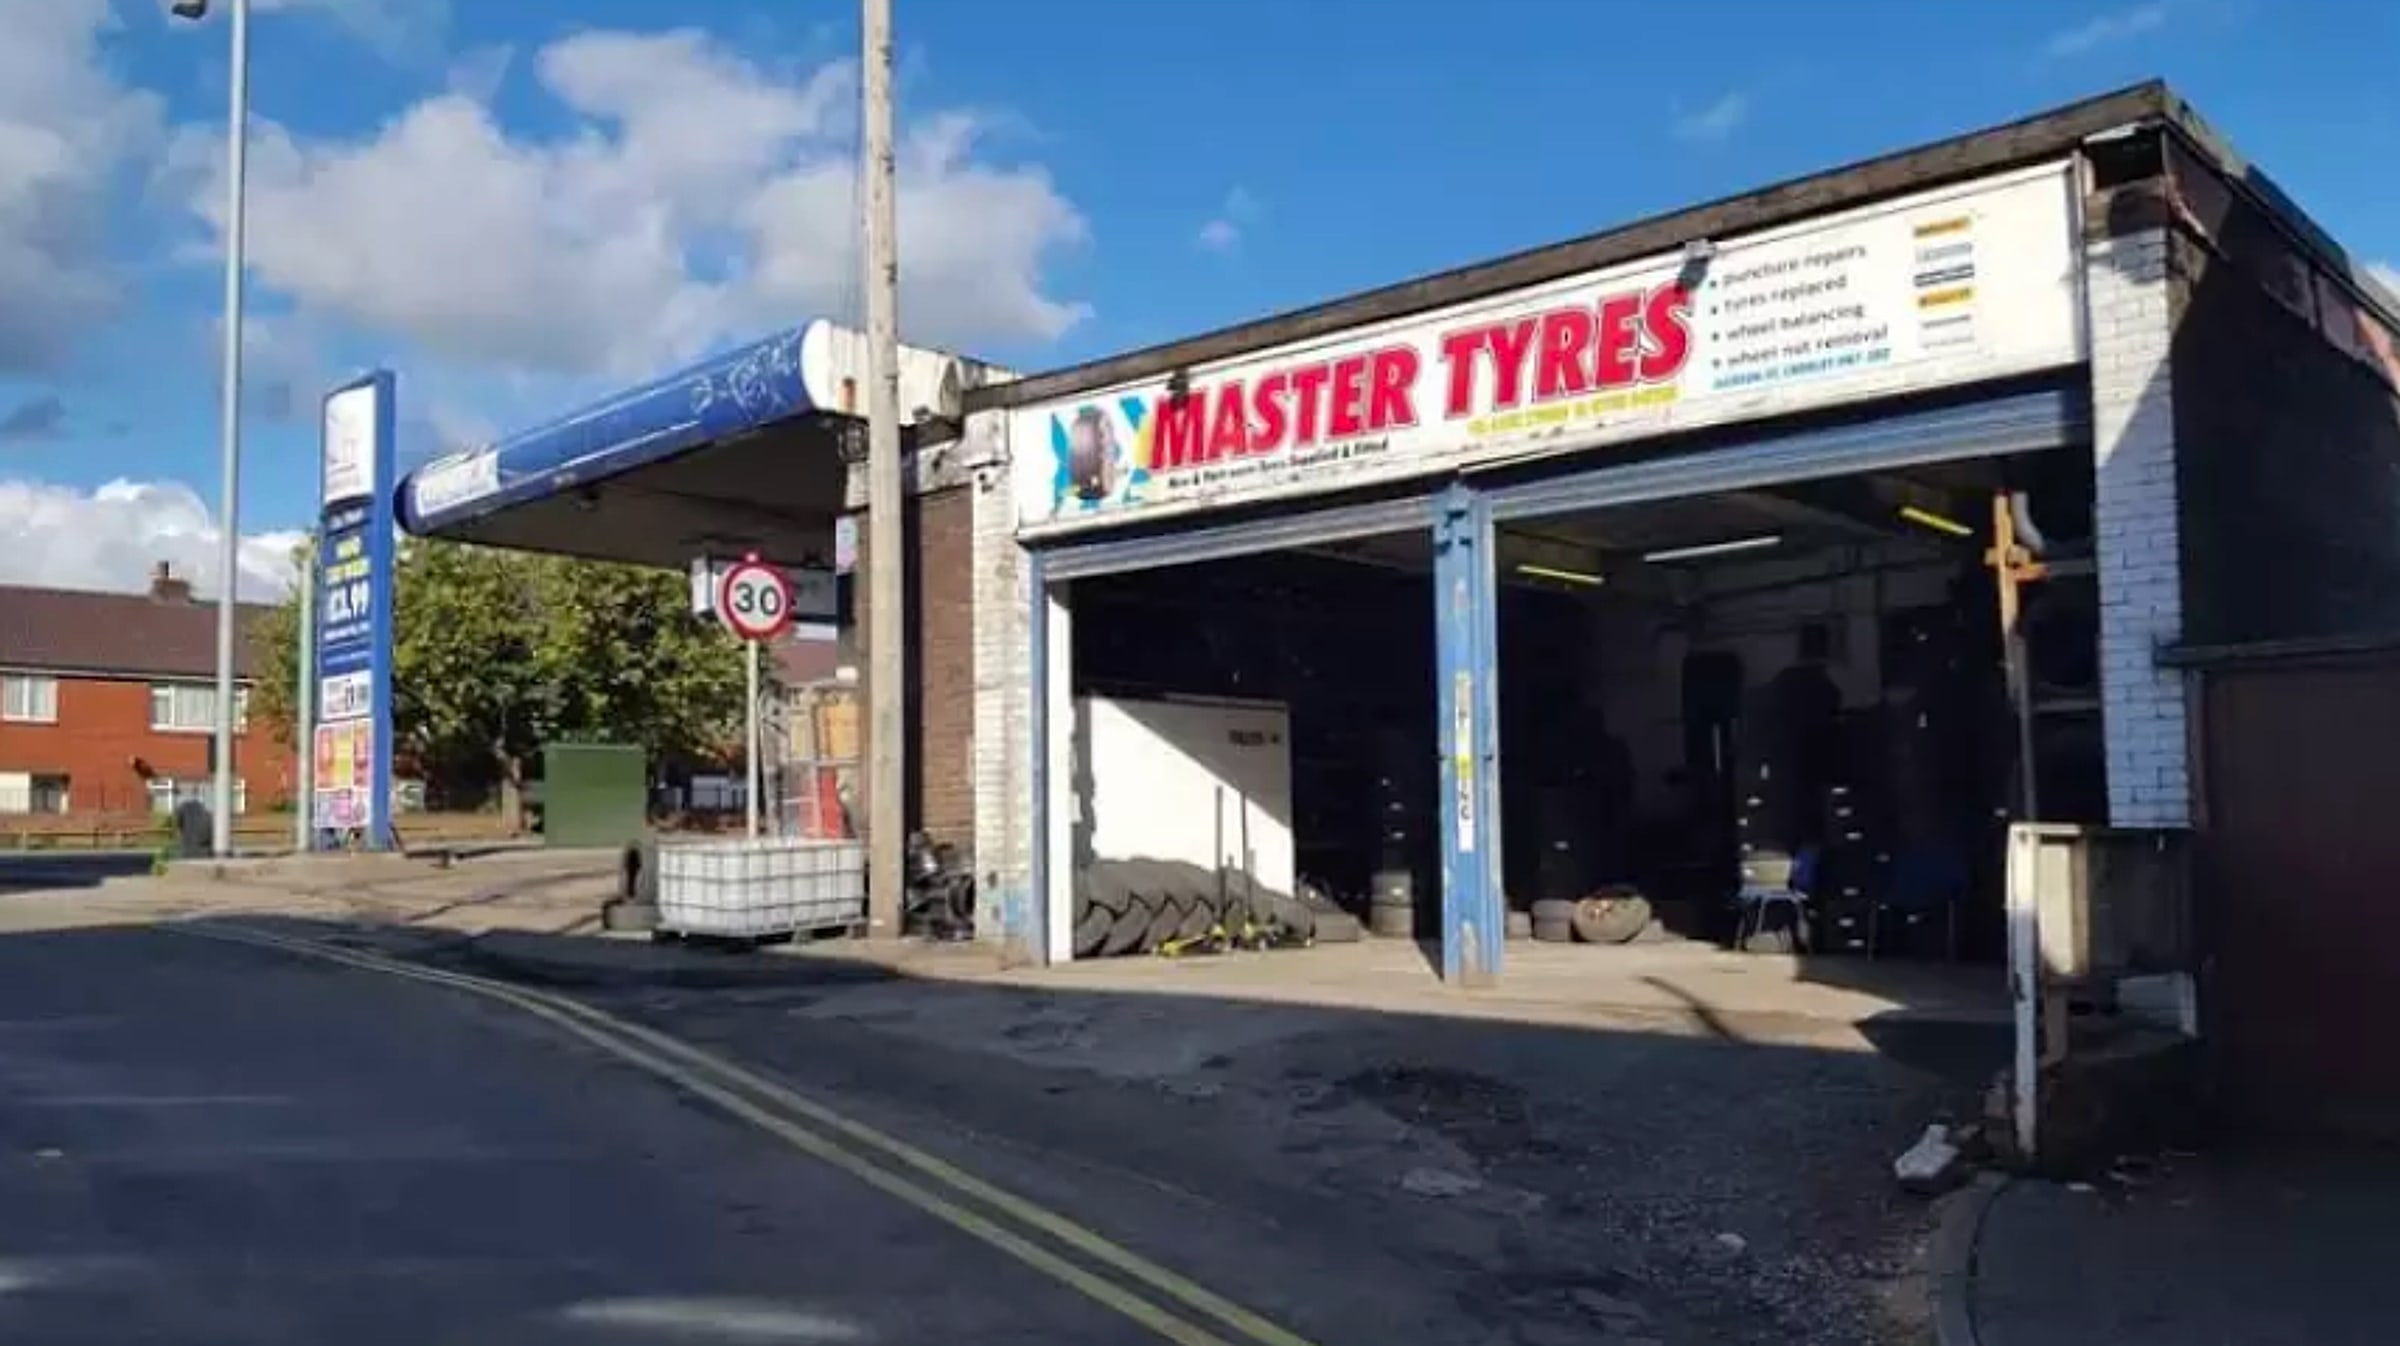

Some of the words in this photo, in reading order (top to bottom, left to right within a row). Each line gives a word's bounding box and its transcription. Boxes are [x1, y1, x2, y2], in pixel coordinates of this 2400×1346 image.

[1723, 259, 1798, 286] puncture
[1804, 245, 1867, 269] repairs
[1771, 274, 1847, 300] replaced
[1727, 318, 1776, 340] wheel
[1781, 304, 1864, 330] balancing
[1728, 344, 1778, 366] wheel
[1783, 341, 1810, 356] nut
[1817, 322, 1889, 349] removal
[1149, 345, 1420, 470] MASTER
[1441, 279, 1690, 417] TYRES
[734, 581, 781, 616] 30
